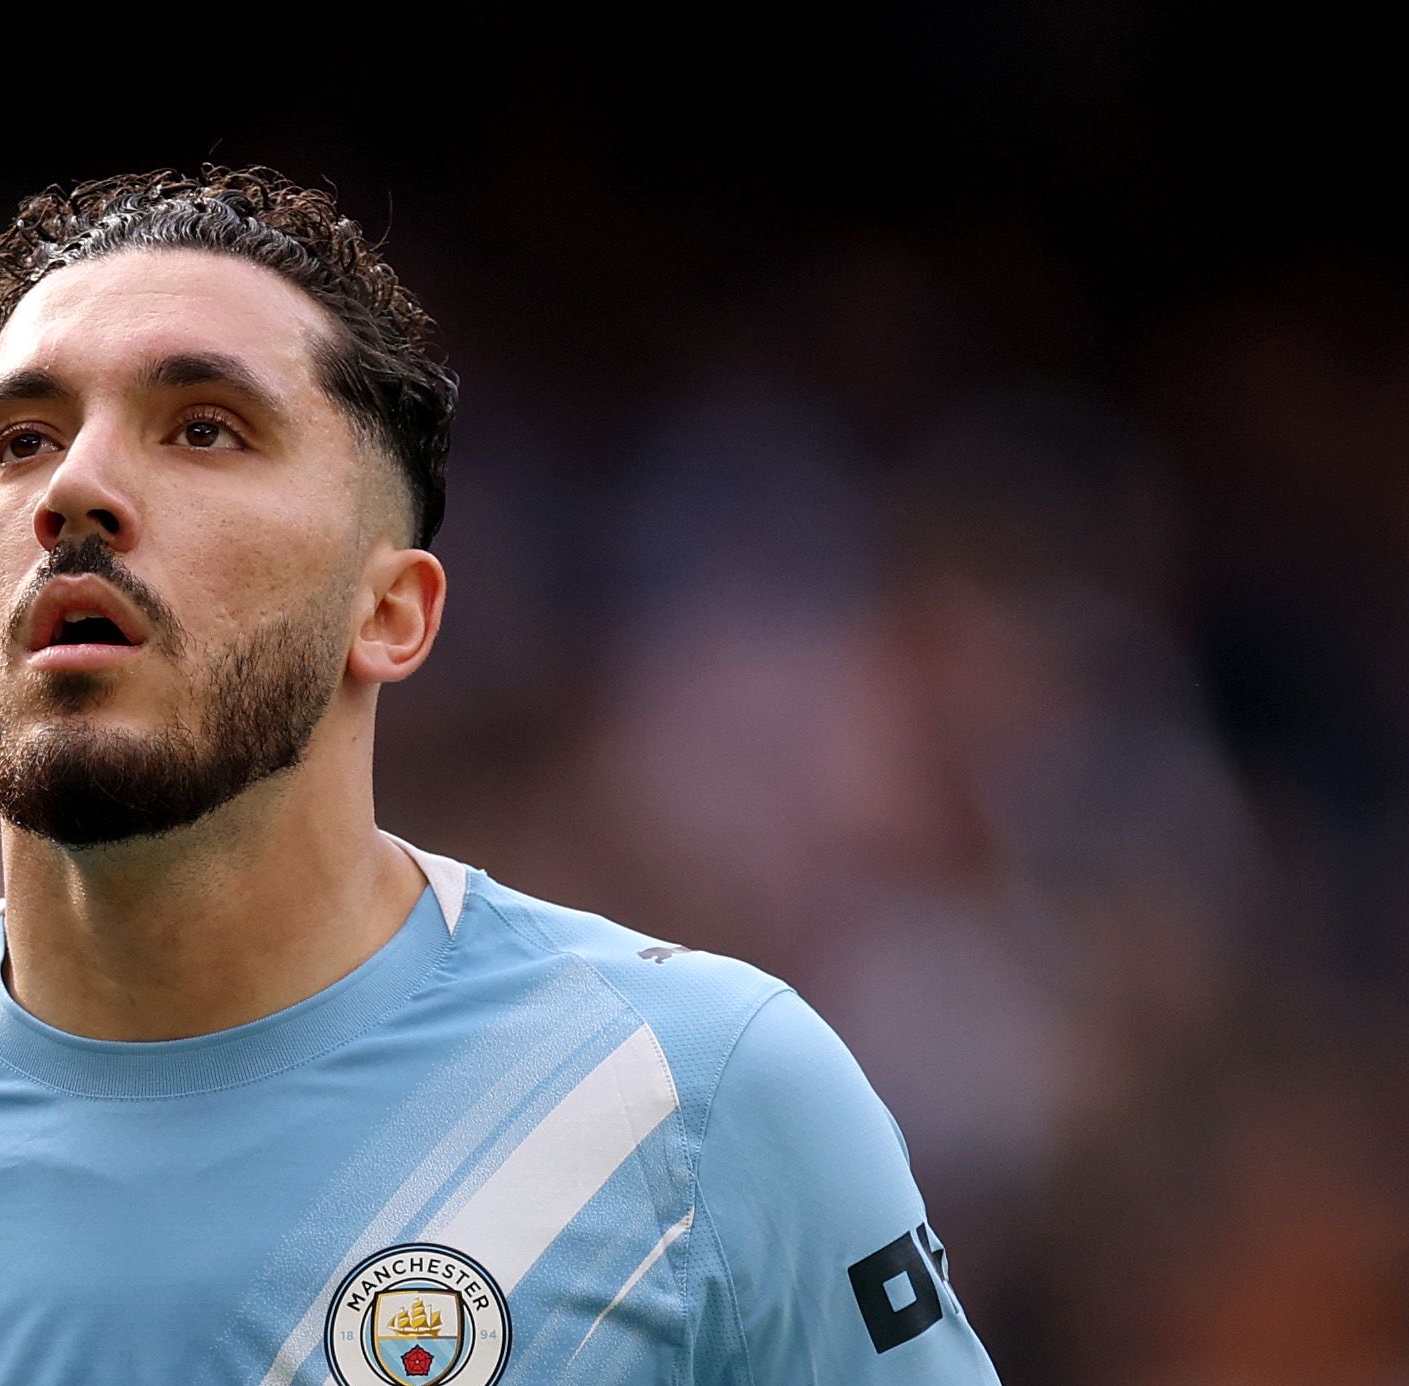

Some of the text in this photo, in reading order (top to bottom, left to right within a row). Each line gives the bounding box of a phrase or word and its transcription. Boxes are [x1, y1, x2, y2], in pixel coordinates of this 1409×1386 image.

[346, 1257, 489, 1312] MANCHESTER
[340, 1331, 354, 1341] 18
[479, 1329, 497, 1340] 94
